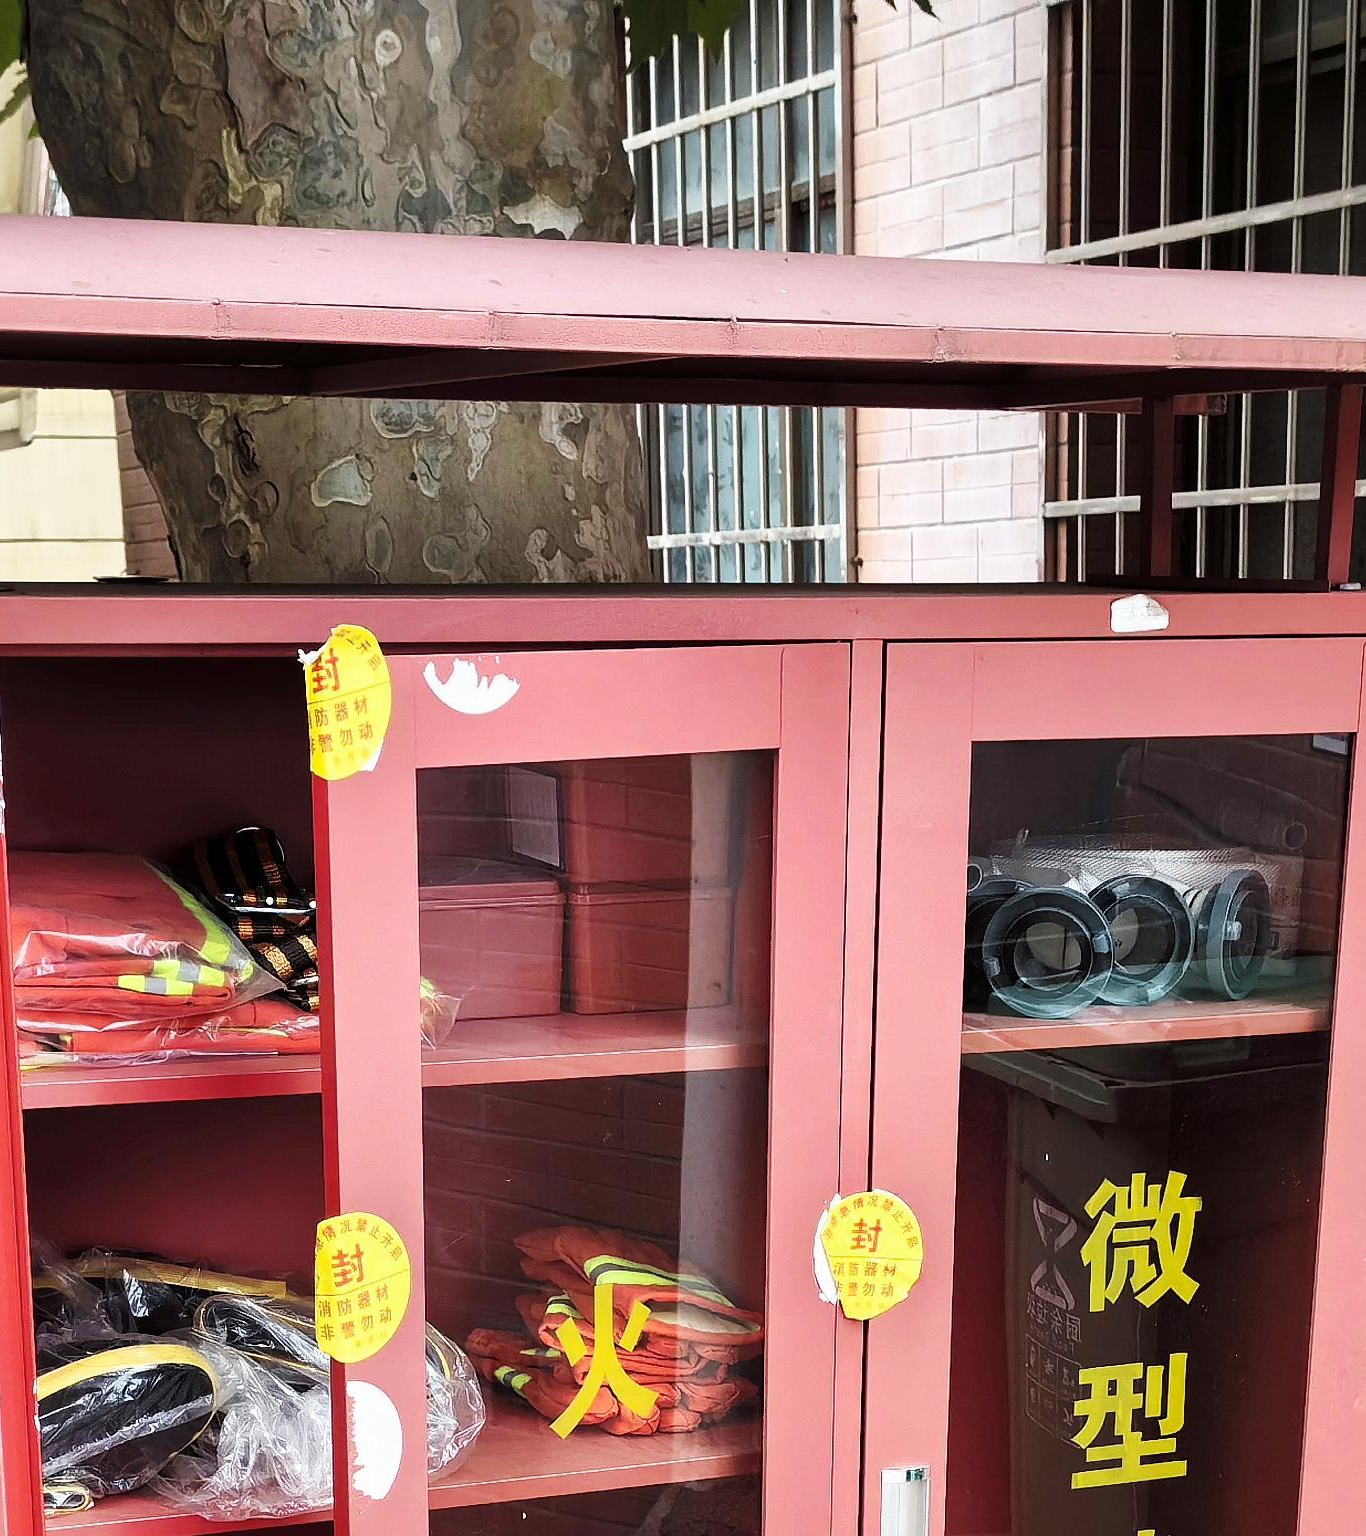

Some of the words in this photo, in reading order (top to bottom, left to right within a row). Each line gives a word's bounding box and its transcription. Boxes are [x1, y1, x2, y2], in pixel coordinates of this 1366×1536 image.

[311, 647, 341, 694] 封
[308, 695, 369, 731] 防器材
[851, 1218, 883, 1253] 封
[331, 1243, 365, 1288] 封
[833, 1261, 897, 1277] 消防器材
[318, 1284, 389, 1318] 消防器材
[320, 1308, 393, 1342] 非警勿动
